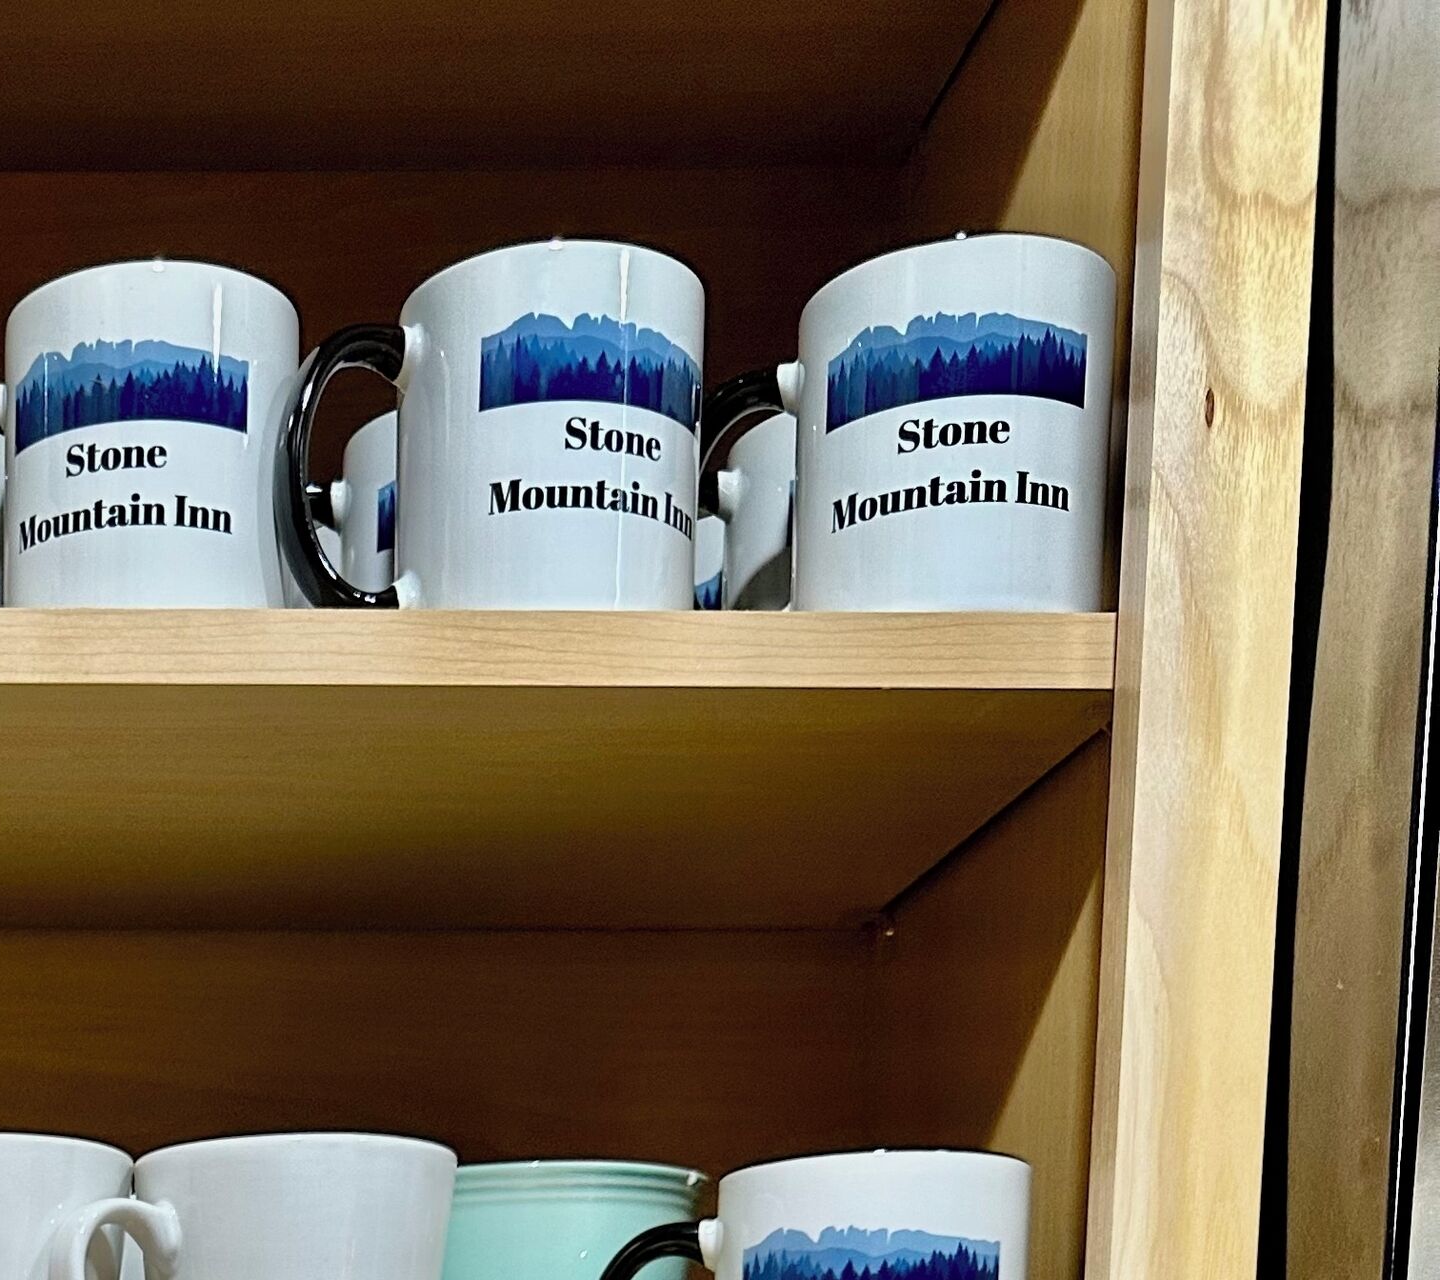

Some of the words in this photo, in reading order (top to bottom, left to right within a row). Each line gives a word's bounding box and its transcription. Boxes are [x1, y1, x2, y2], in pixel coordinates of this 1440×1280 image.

[65, 442, 169, 479] Stone
[564, 416, 662, 462] Stone
[896, 418, 1011, 455] Stone
[18, 493, 165, 554] Mountain
[172, 495, 233, 535] Inn
[488, 478, 660, 520] Mountain
[663, 493, 695, 541] Inn
[830, 470, 1008, 535] Mountain
[1014, 470, 1071, 513] Inn
